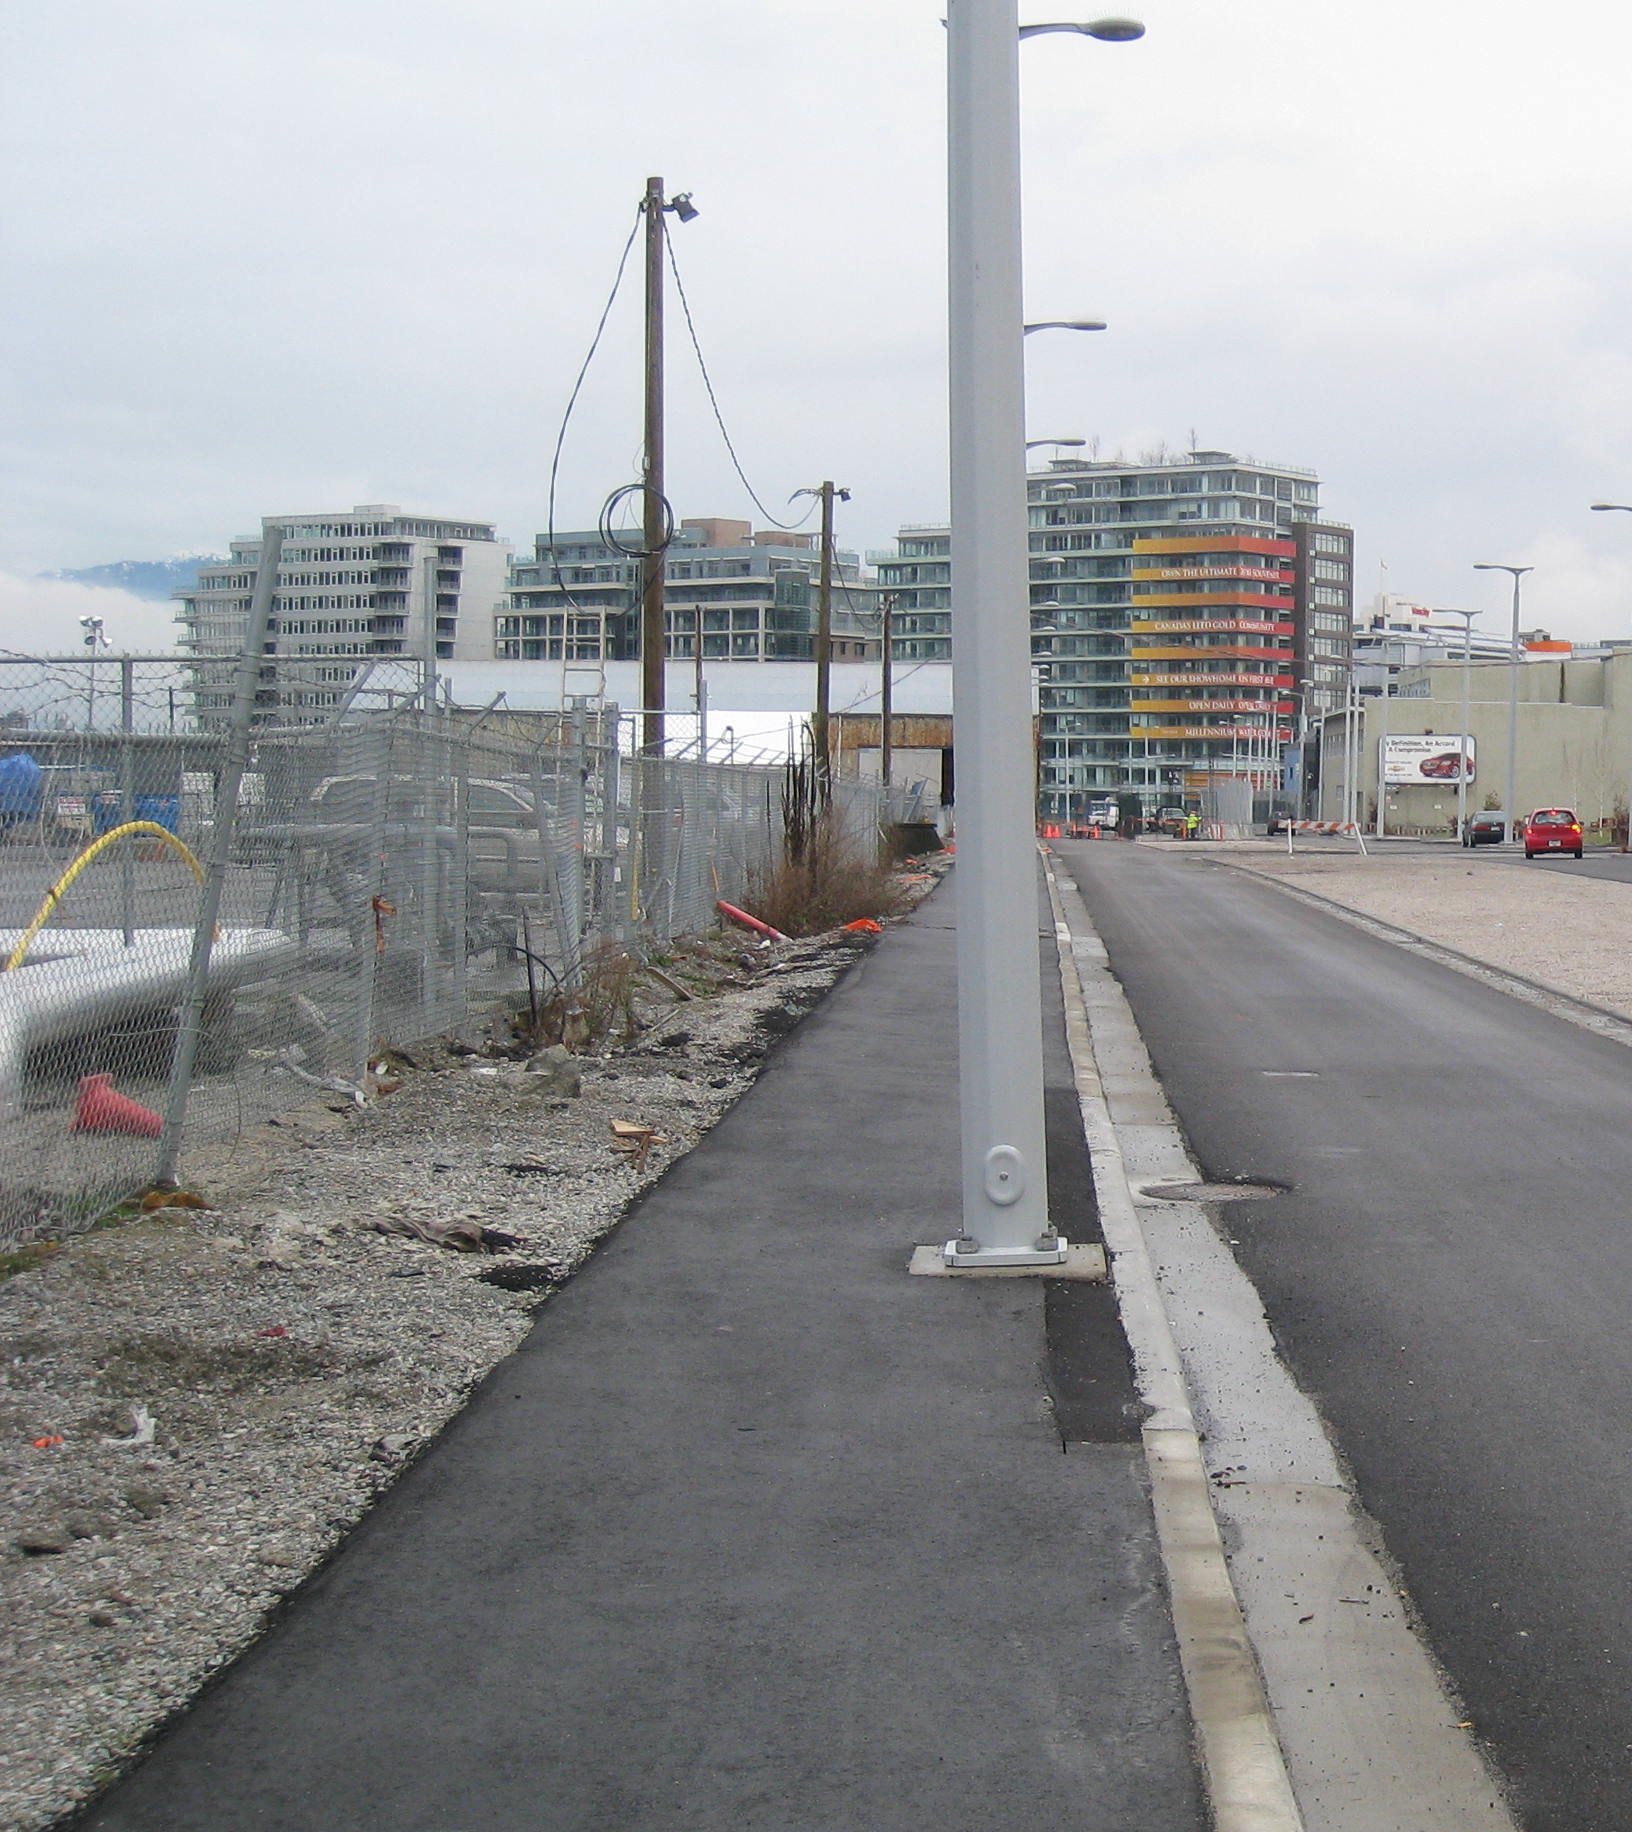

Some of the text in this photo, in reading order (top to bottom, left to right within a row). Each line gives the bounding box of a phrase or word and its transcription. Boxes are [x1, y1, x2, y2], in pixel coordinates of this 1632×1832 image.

[1199, 566, 1237, 577] ULTIMATE
[1212, 620, 1236, 629] GOLD
[1170, 674, 1188, 684] OUR
[1188, 700, 1211, 710] OPEN
[1212, 700, 1235, 710] DAILY
